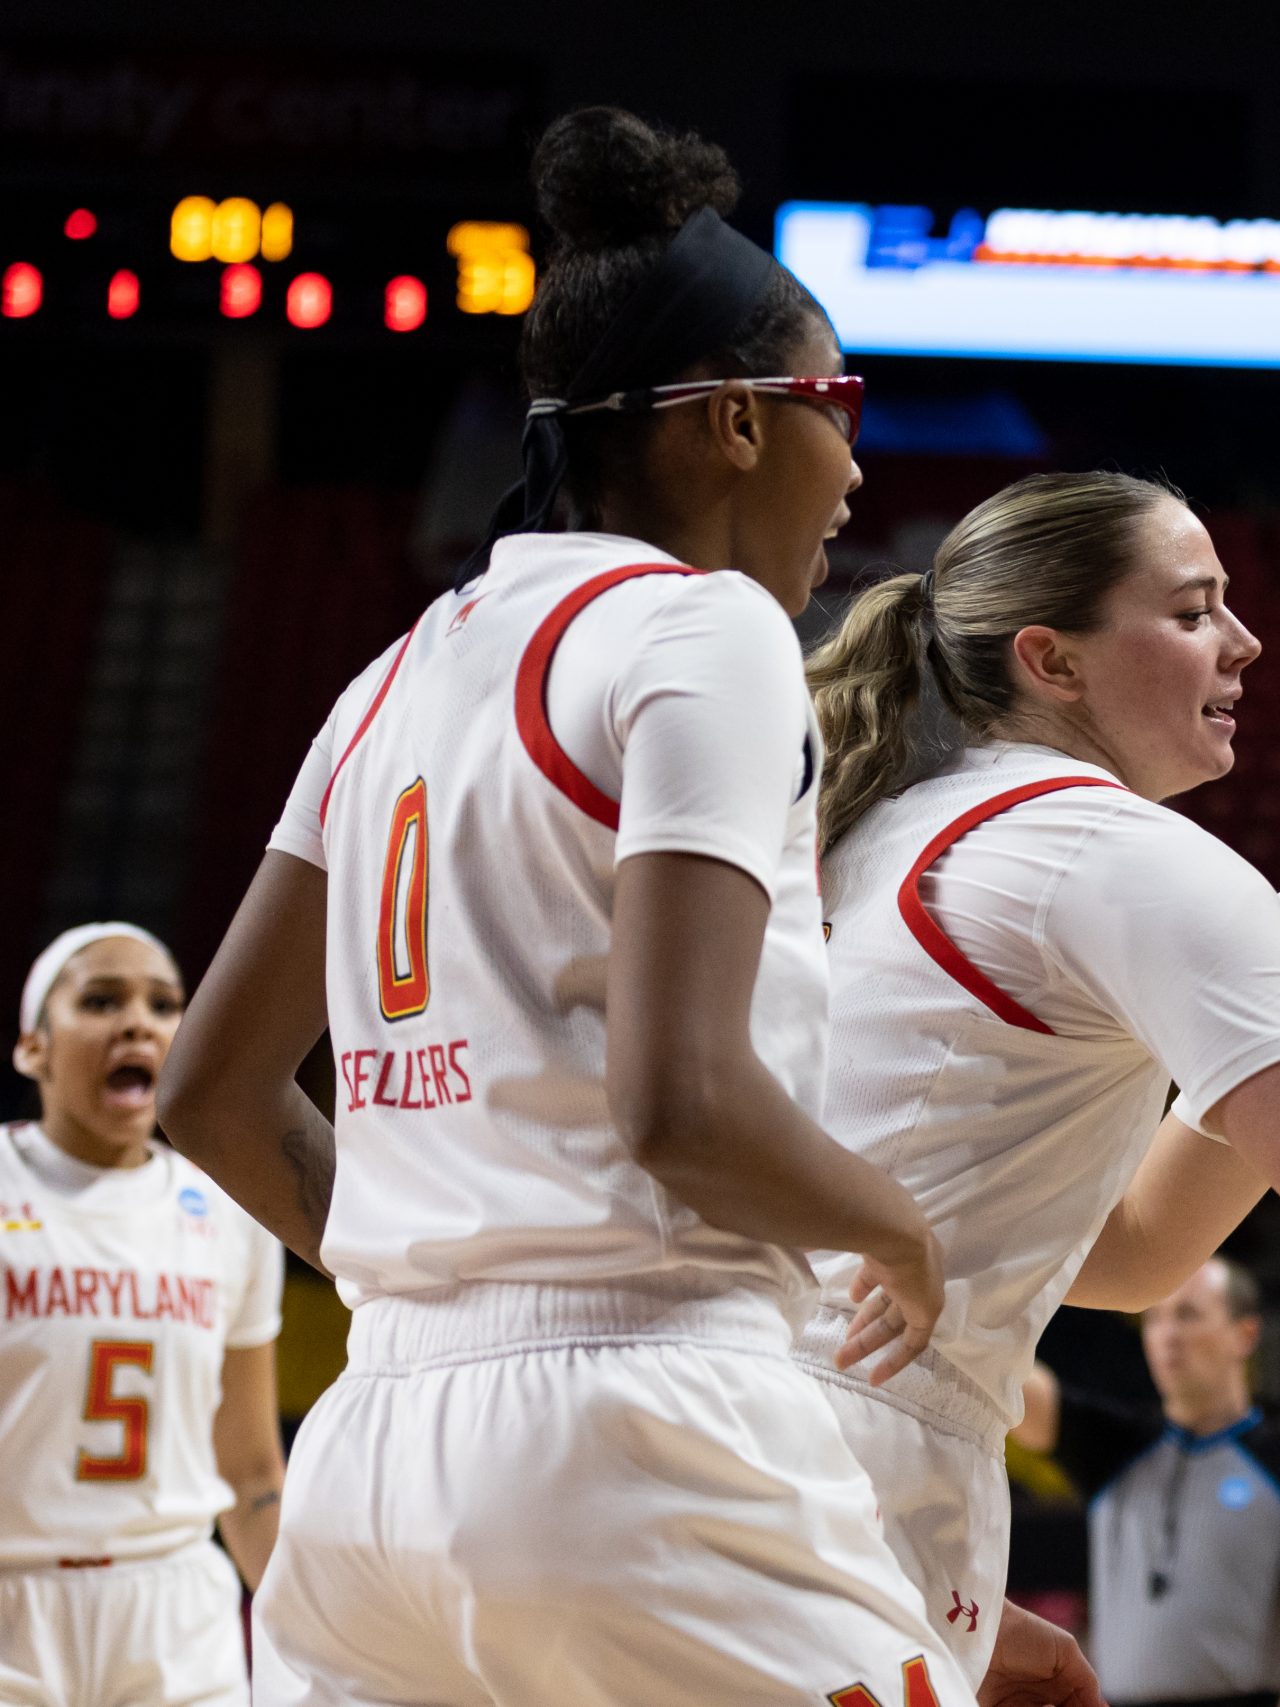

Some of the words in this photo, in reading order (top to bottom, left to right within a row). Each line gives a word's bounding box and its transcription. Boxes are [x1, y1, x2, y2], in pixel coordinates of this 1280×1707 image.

[376, 775, 430, 1023] 0
[341, 1040, 472, 1113] SELLERS
[5, 1264, 216, 1330] MARYLAND
[75, 1339, 155, 1482] 5
